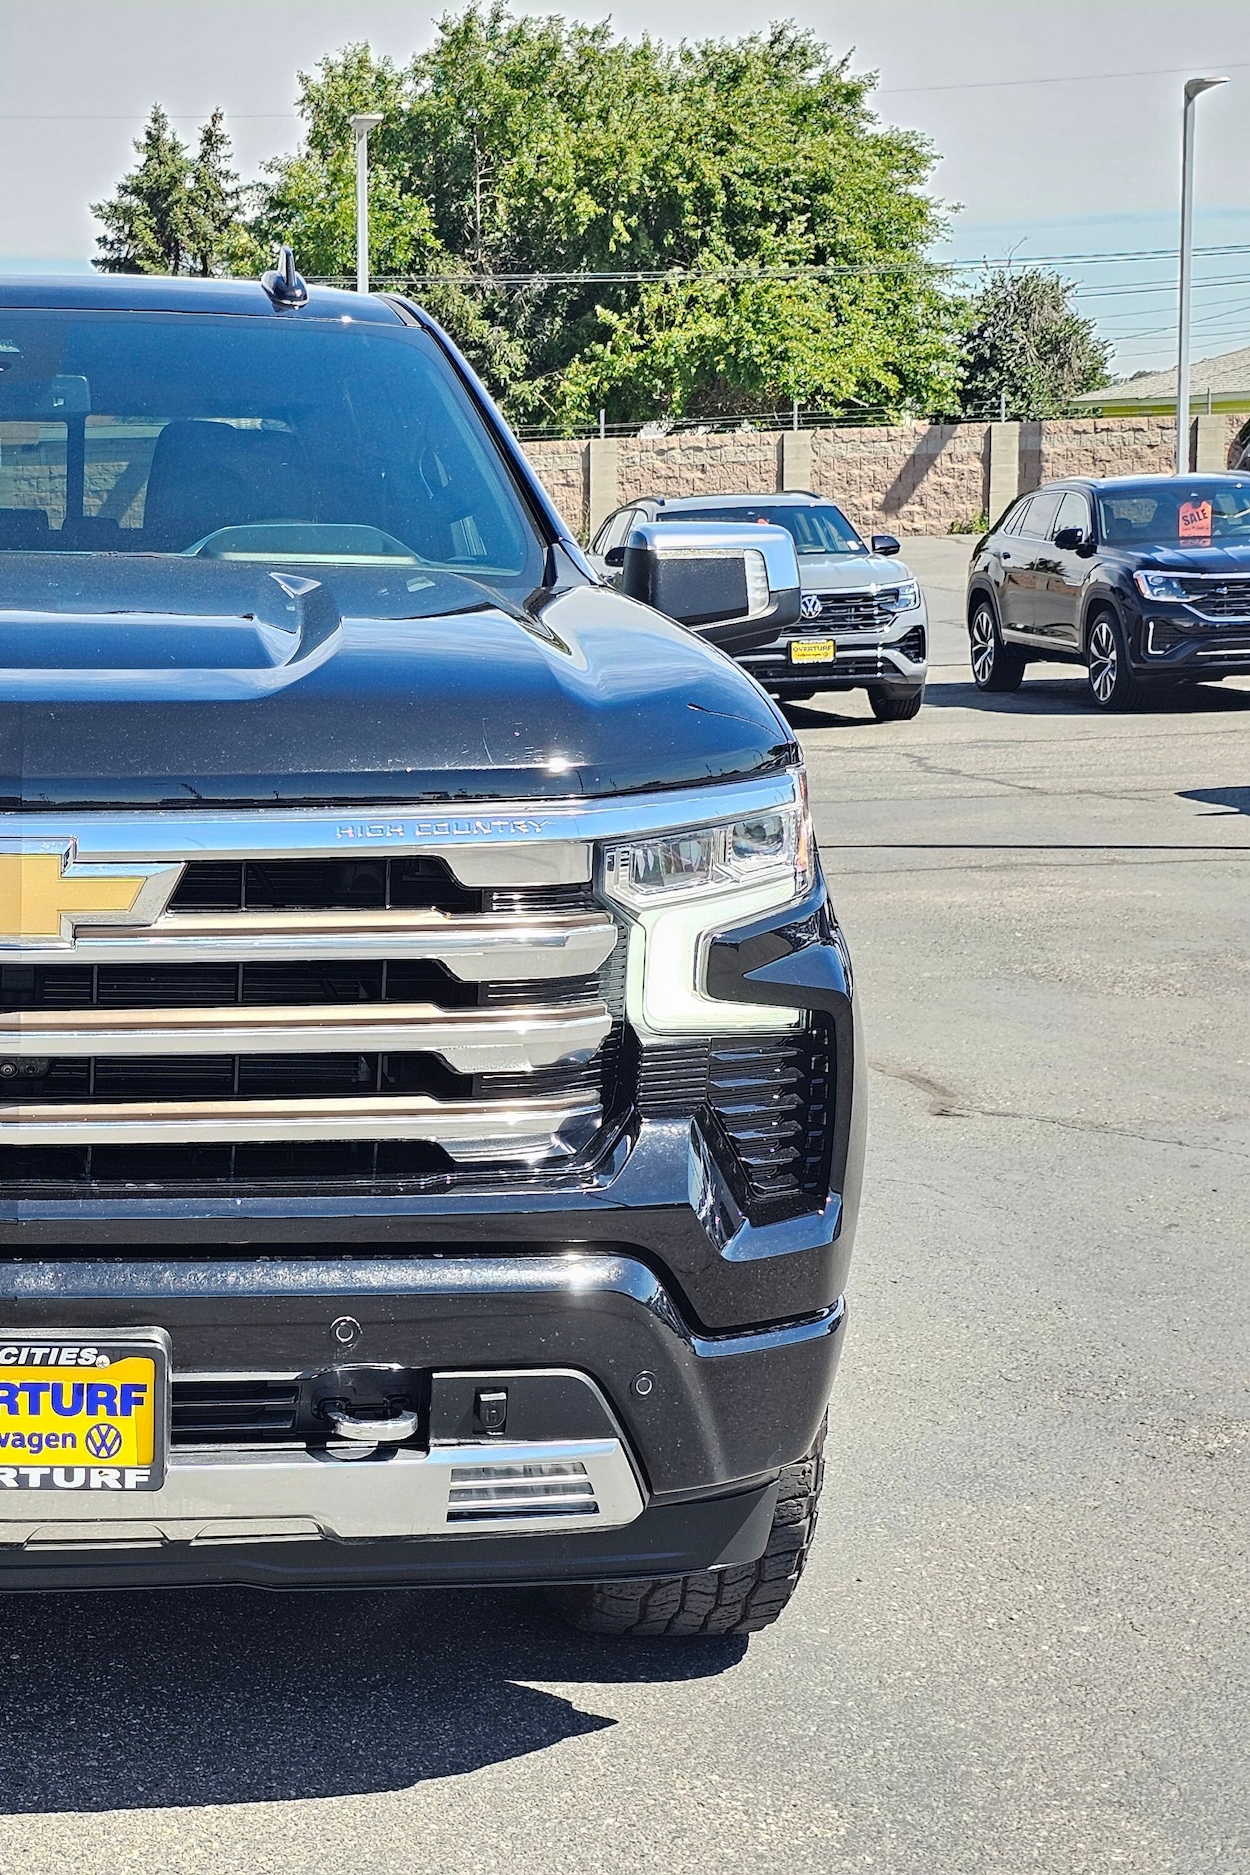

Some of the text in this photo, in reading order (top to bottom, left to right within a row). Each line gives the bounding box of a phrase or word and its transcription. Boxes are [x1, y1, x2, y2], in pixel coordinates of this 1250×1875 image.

[1182, 509, 1209, 526] SALE
[336, 819, 549, 839] HIGH COUNTRY
